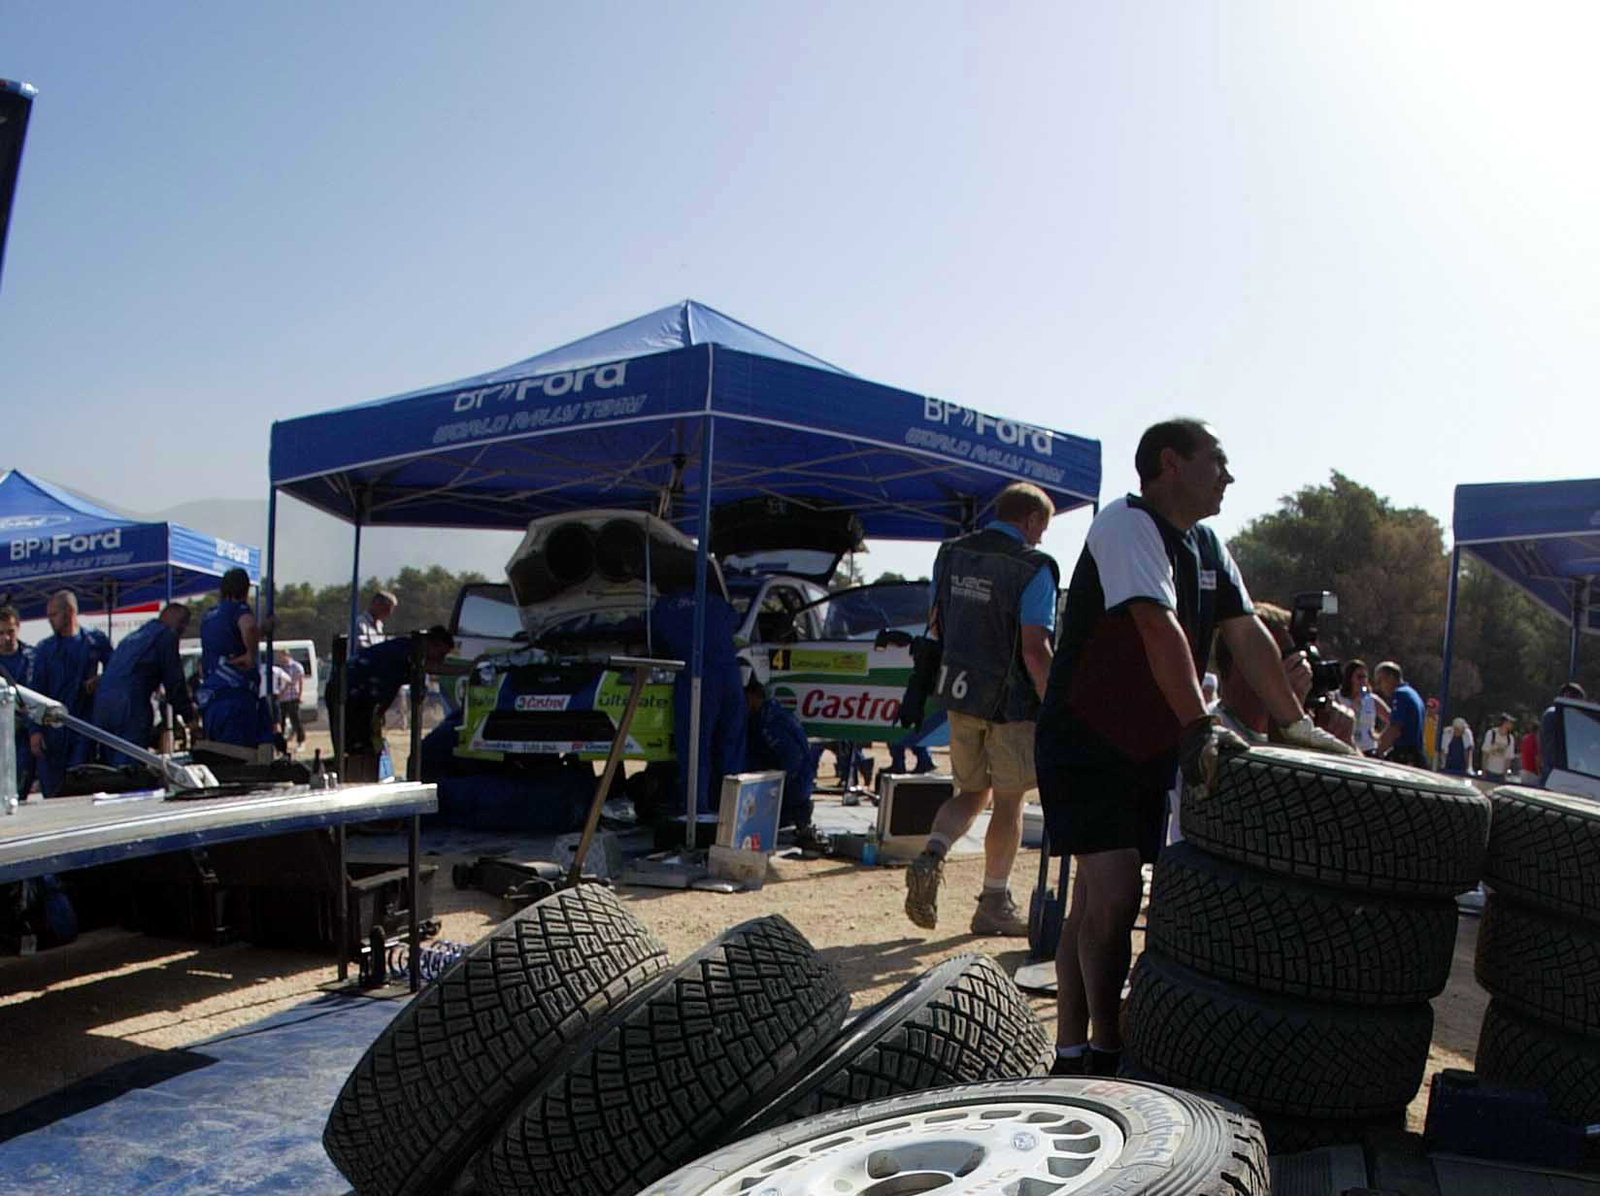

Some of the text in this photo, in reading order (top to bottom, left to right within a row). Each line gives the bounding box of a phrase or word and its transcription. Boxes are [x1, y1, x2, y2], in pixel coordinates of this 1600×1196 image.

[515, 361, 630, 401] Ford
[9, 528, 122, 561] BP Ford
[772, 650, 785, 670] 4
[937, 665, 969, 699] 16
[801, 688, 903, 722] Castro
